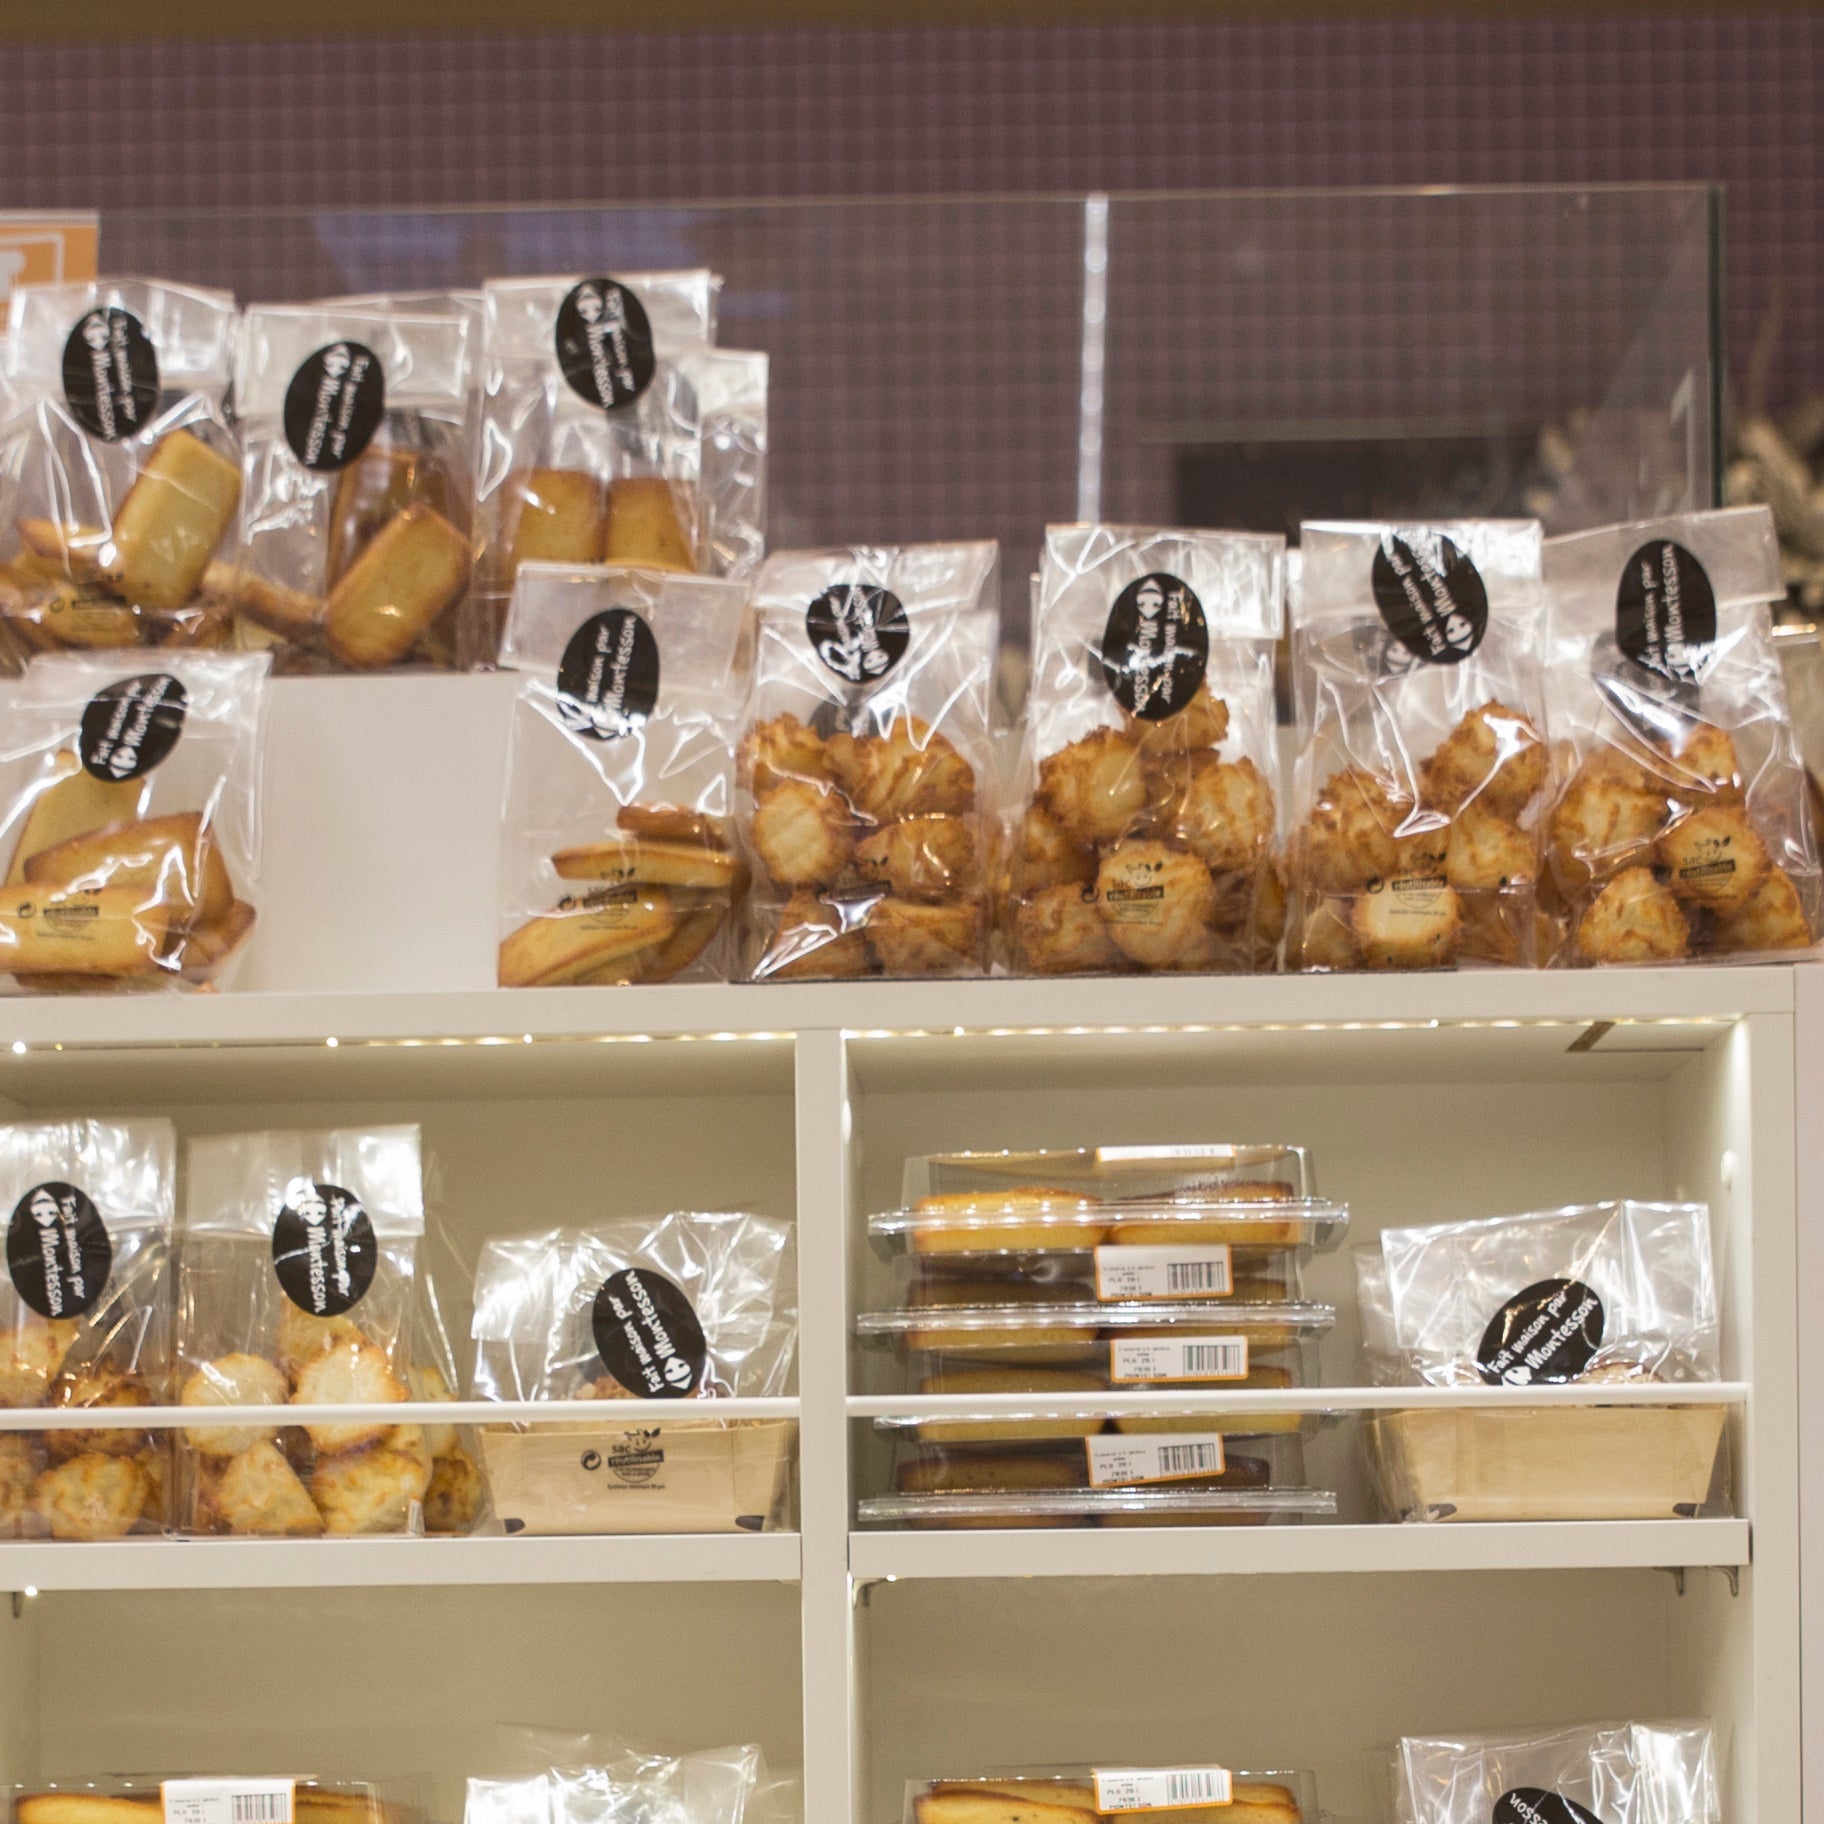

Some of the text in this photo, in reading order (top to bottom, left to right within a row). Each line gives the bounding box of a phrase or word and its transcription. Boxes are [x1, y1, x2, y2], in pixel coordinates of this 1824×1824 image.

[91, 349, 116, 441] Montesson
[117, 394, 137, 423] par
[305, 377, 342, 465] Montesson
[329, 356, 370, 460] Fait maison par
[1402, 575, 1433, 624] maison
[1640, 560, 1658, 589] par
[1661, 543, 1687, 641] Montesson
[596, 622, 612, 654] par
[601, 614, 637, 711] Montesson
[1134, 617, 1158, 712] Moesson
[1423, 624, 1447, 655] Fait
[37, 1228, 64, 1317] Montesson
[60, 1196, 86, 1299] Fait maison par
[306, 1227, 329, 1313] Montesson
[608, 1296, 665, 1393] Fait maison par
[625, 1270, 676, 1359] Montesson
[1486, 1290, 1568, 1374] Fait maison par
[1523, 1298, 1599, 1370] Montesson
